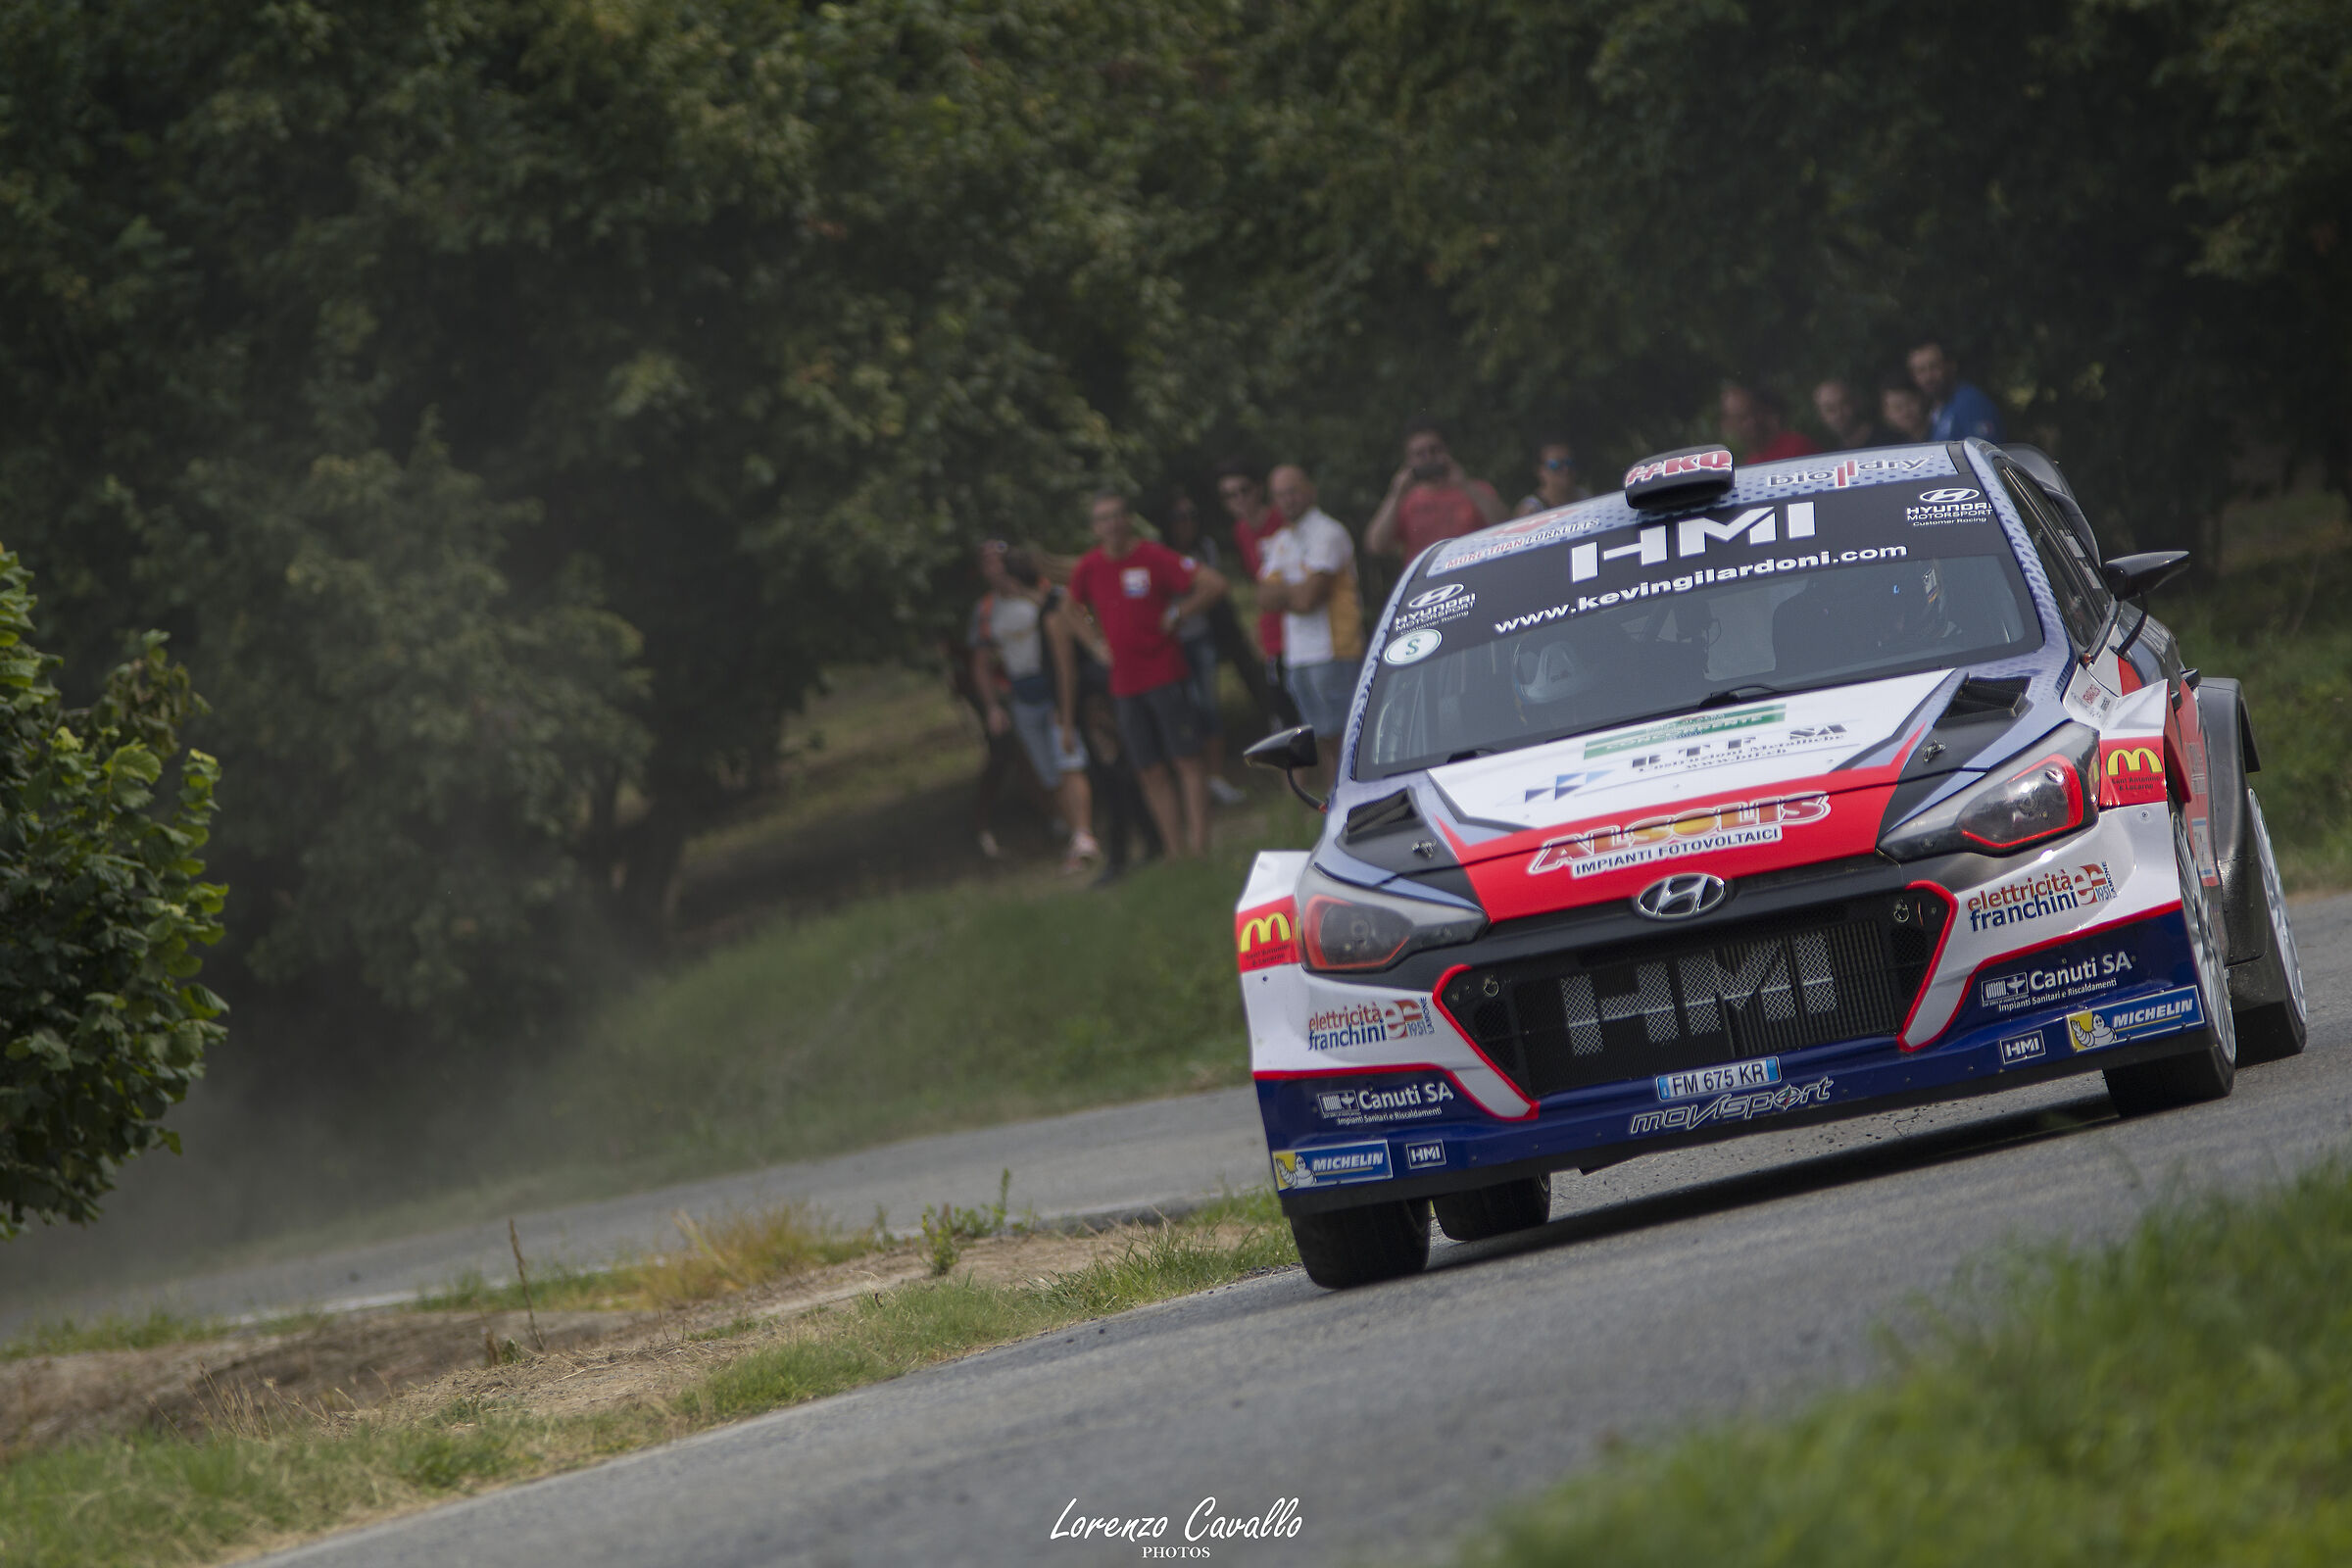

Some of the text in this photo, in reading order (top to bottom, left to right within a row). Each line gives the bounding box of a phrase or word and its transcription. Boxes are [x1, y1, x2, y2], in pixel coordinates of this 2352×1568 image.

[1907, 509, 1993, 521] MOTORSPORT
[1488, 538, 1524, 557] THAN
[1571, 501, 1816, 583] HMI
[1494, 543, 1908, 635] www.kevingilardoni.com
[1396, 593, 1476, 625] HYUNDAI
[1405, 638, 1421, 656] S
[1575, 827, 1781, 876] IMPIANTI FOTOVOLTAICI
[1967, 868, 2072, 911] elettricità
[1970, 885, 2080, 932] franchini
[2030, 951, 2133, 991] Canuti SA
[1559, 931, 1841, 1058] HMI
[1998, 996, 2032, 1012] Impianti
[2032, 990, 2061, 1005] Sanitari
[2068, 978, 2118, 999] Riscaldamenti
[1308, 1001, 1383, 1031] elettricità
[2113, 999, 2194, 1029] MICHELIN
[1307, 1017, 1387, 1051] franchini
[2004, 1037, 2040, 1058] HMI
[1358, 1081, 1455, 1110] Canuti SA
[1672, 1063, 1765, 1096] FM 675 KR
[1336, 1115, 1364, 1126] Impianti
[1363, 1112, 1390, 1123] Sanitari
[1395, 1105, 1443, 1121] Riscaldamenti
[1312, 1152, 1385, 1172] MICHELIN
[1409, 1145, 1442, 1163] HMI
